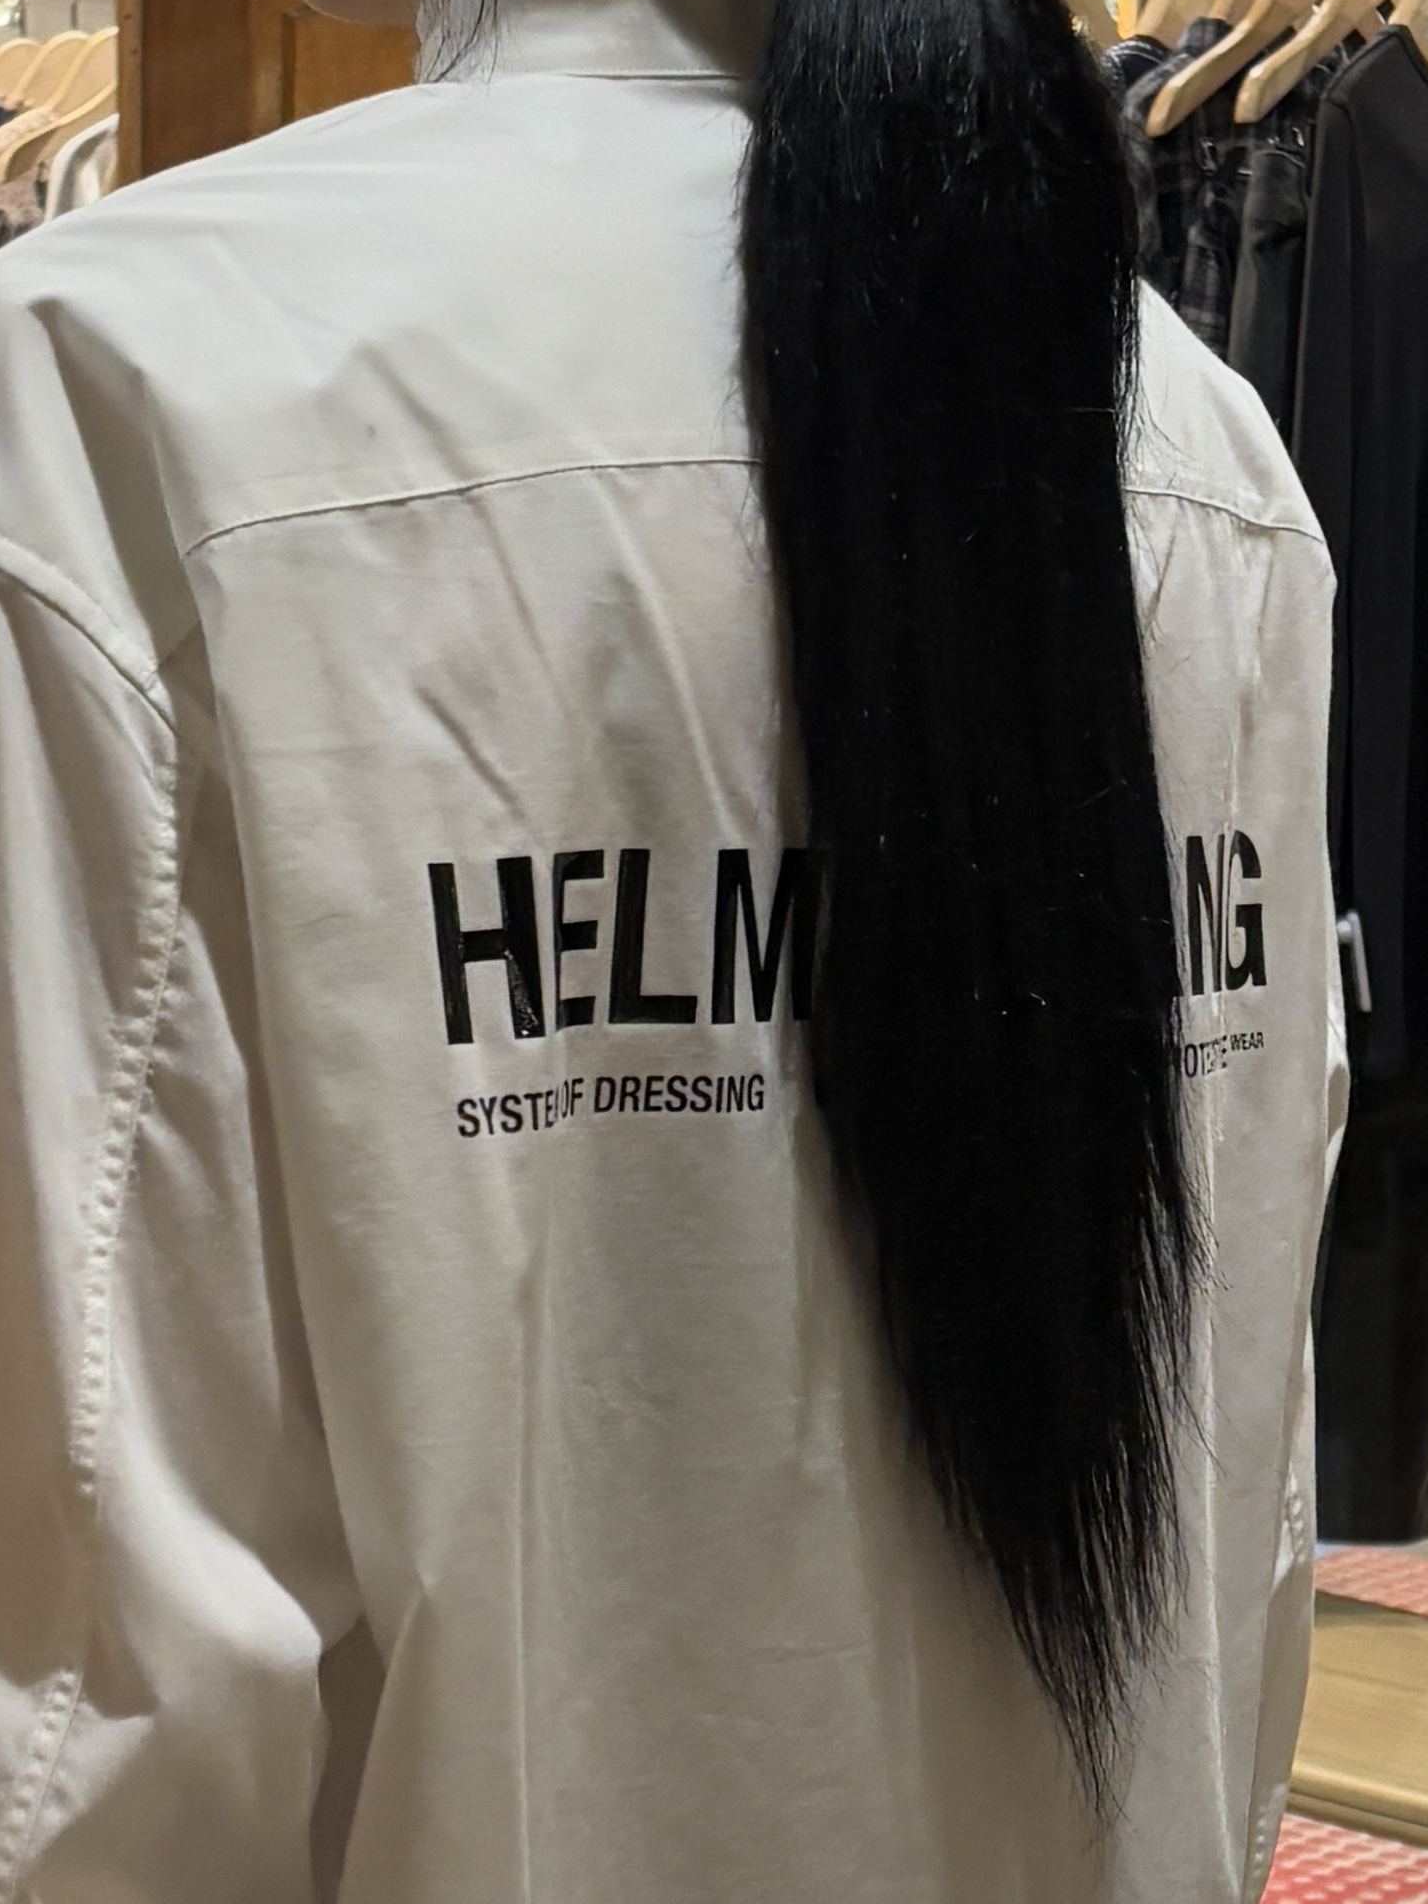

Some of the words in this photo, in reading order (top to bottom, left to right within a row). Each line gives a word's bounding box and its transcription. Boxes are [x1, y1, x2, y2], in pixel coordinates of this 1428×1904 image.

[427, 847, 826, 1045] HELM
[1184, 830, 1267, 996] NG
[457, 1086, 559, 1138] SYSTE
[560, 1077, 584, 1118] OF
[594, 1074, 765, 1113] DRESSING
